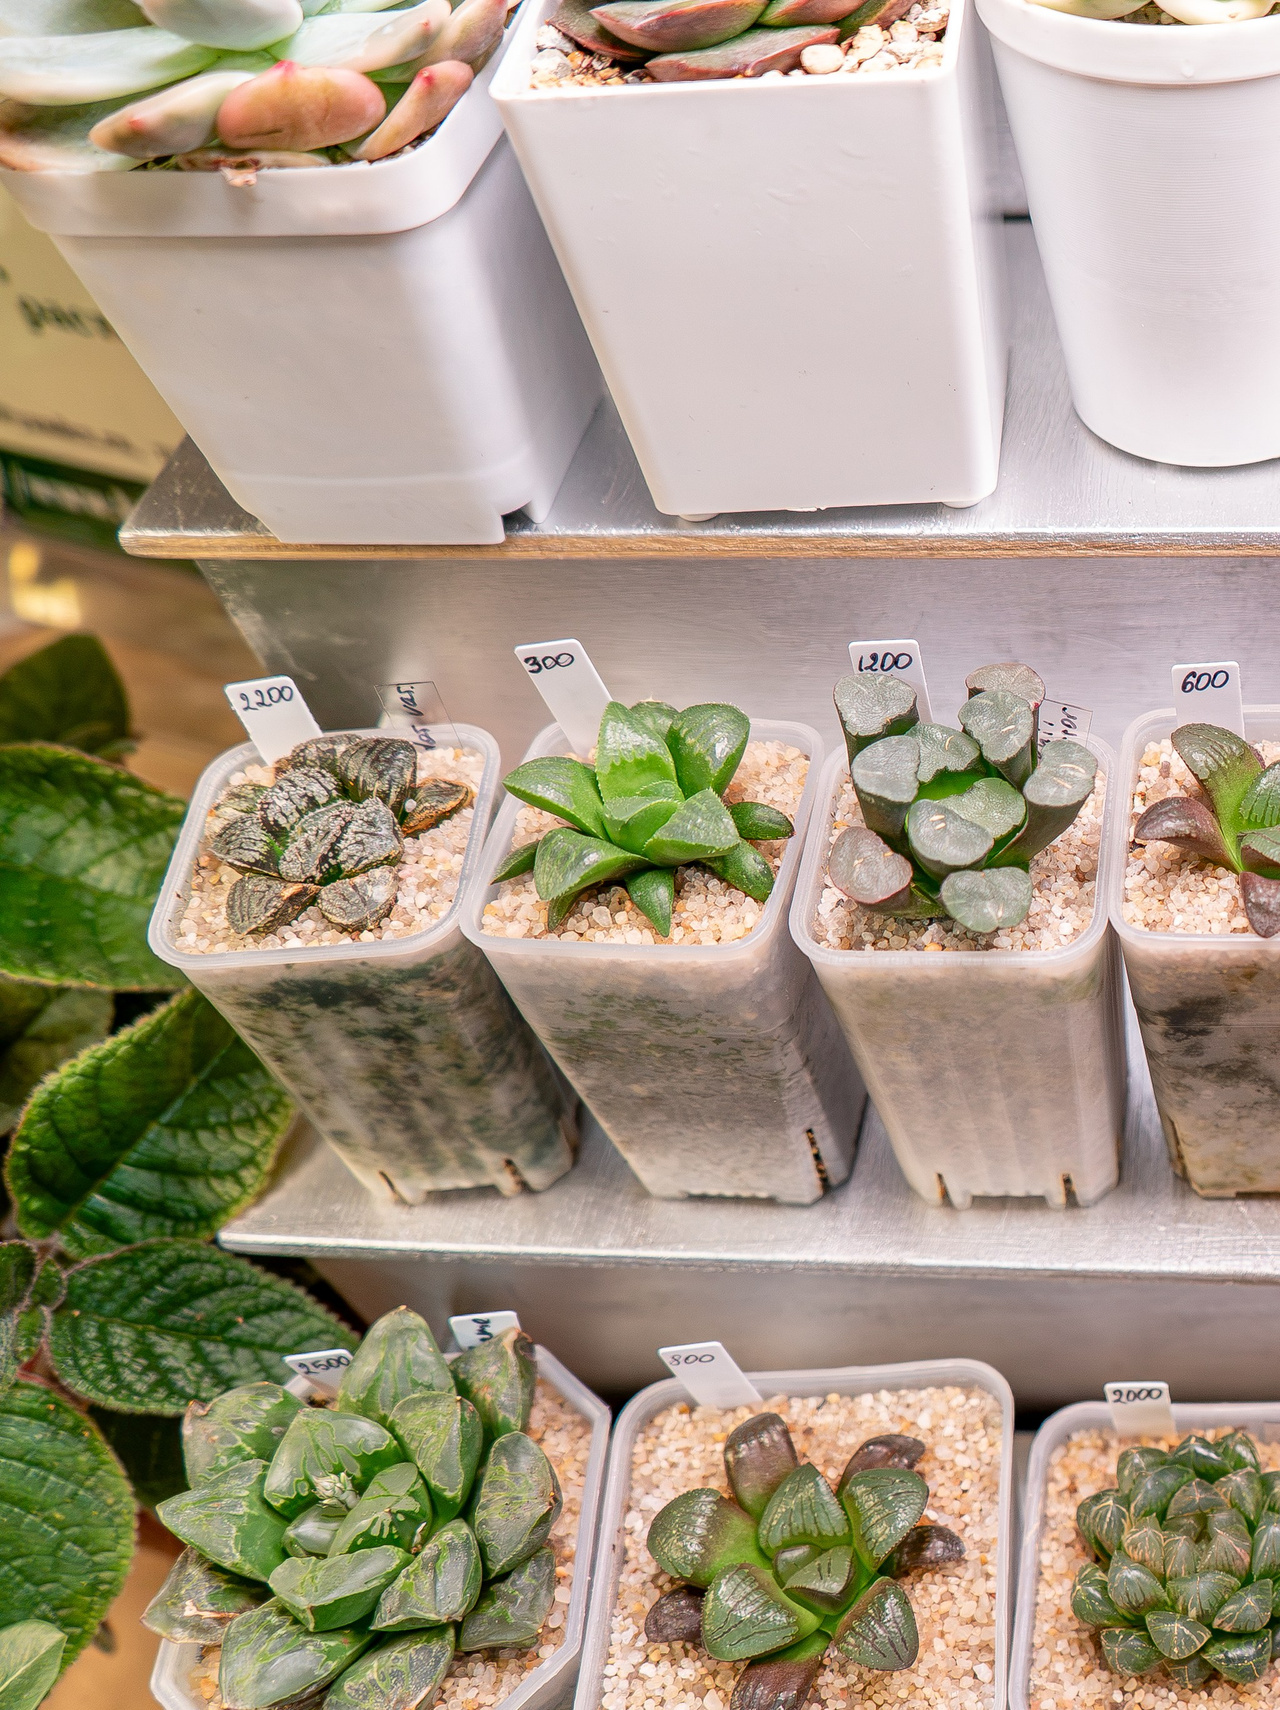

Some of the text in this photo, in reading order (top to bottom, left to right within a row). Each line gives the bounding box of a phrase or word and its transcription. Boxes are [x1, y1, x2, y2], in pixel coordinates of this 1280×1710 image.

[523, 652, 575, 674] 300
[858, 651, 913, 672] 1200
[1181, 669, 1230, 694] 600
[239, 685, 294, 711] 2200
[297, 1355, 351, 1375] 2500
[1112, 1388, 1162, 1405] 2000
